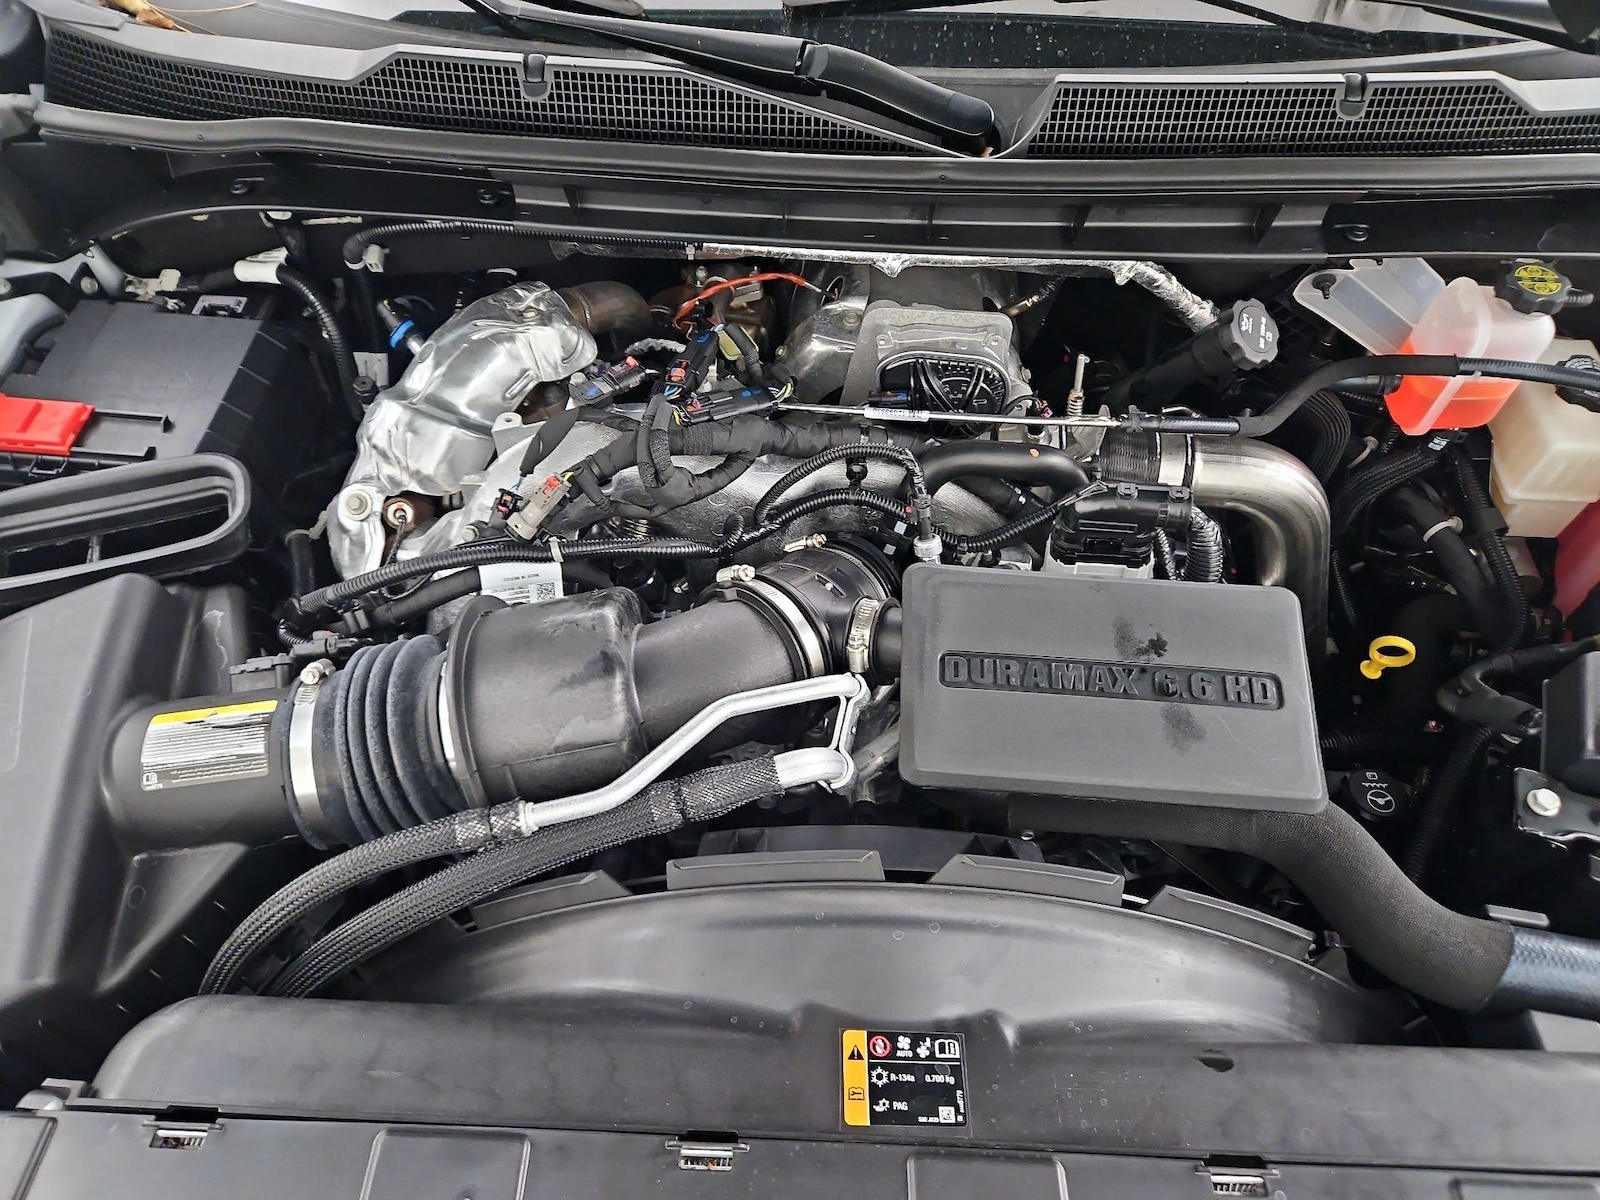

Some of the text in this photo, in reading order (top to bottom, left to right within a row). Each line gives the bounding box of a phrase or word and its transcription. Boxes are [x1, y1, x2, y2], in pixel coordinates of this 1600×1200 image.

[944, 655, 1278, 706] DURAMAX 6.6 HD
[890, 1073, 955, 1085] R-134a 0.700 kg
[893, 1101, 908, 1110] PAG
